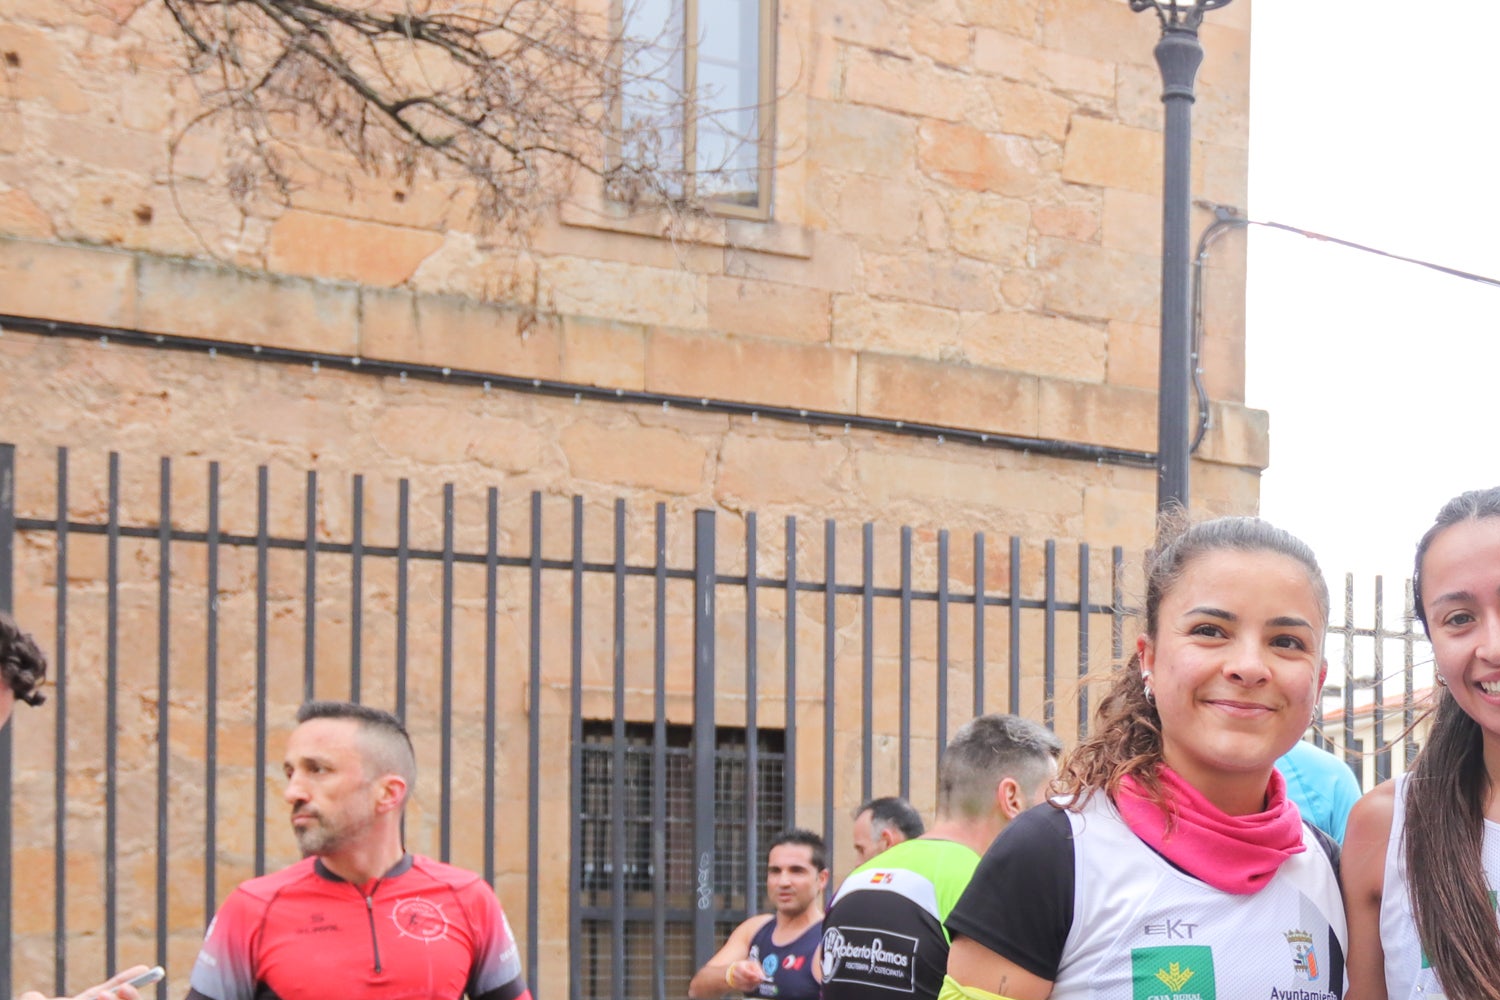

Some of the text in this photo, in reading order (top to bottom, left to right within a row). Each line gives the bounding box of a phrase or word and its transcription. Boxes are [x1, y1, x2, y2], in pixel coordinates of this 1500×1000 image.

[1145, 919, 1198, 939] EKT
[832, 934, 908, 967] Roberto Ramos
